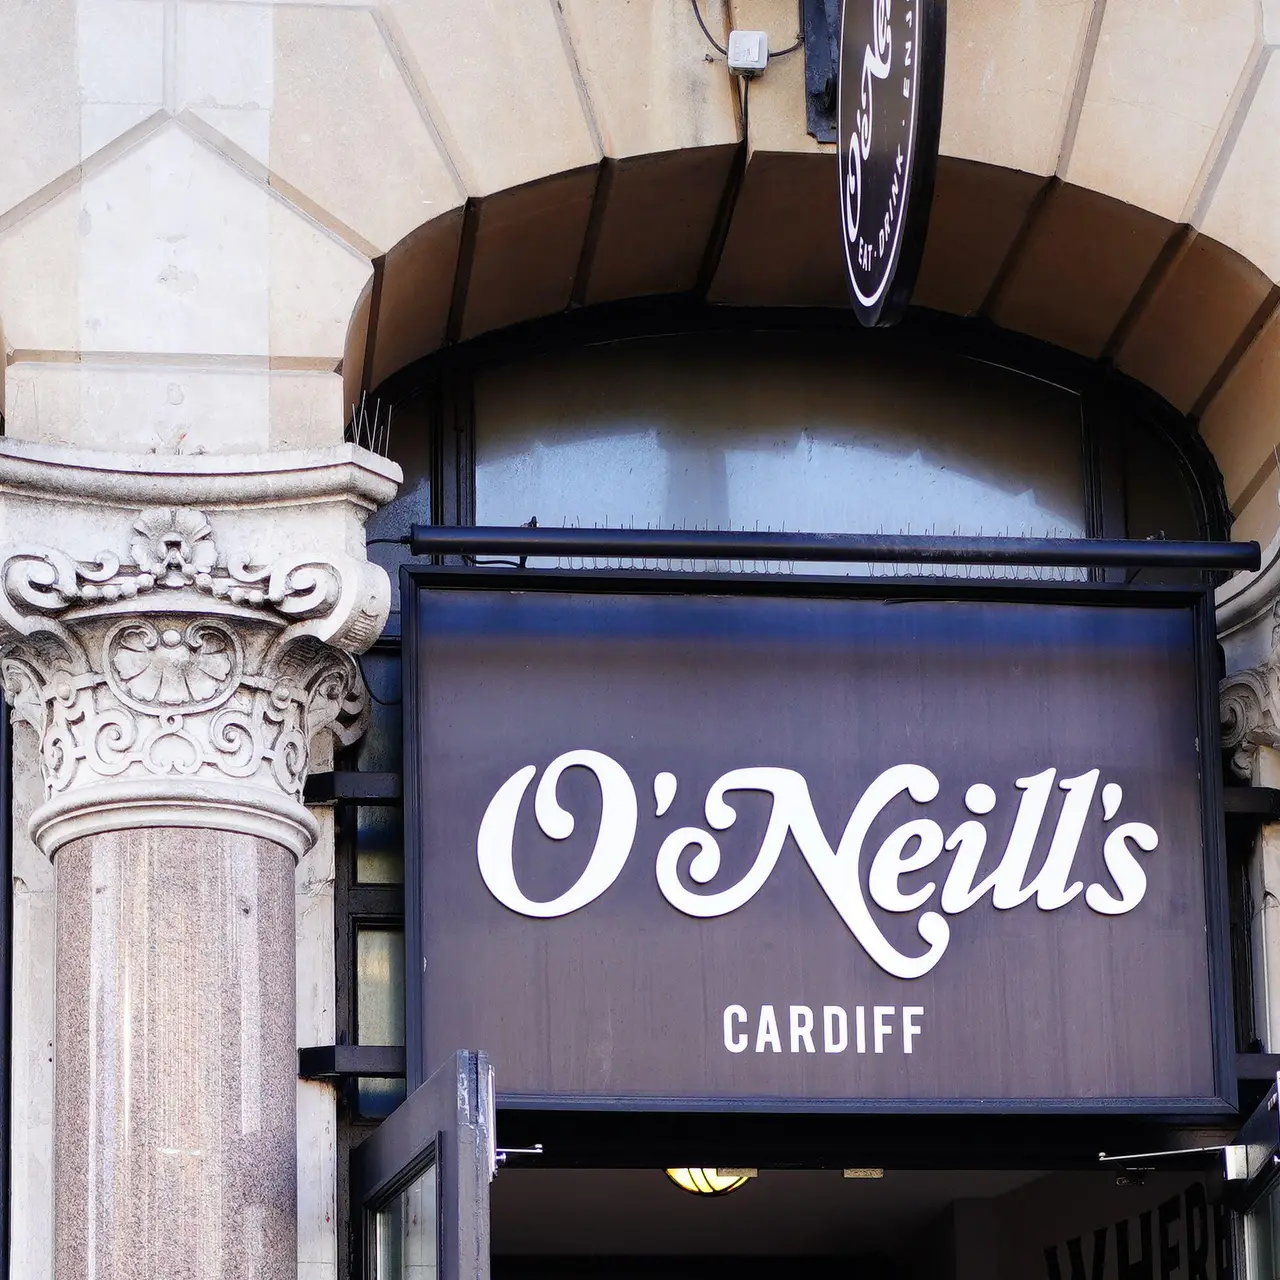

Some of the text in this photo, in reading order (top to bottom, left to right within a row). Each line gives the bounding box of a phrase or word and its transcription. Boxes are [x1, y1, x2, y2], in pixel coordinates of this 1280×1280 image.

[858, 236, 873, 272] EAT
[878, 143, 904, 258] DRINK
[477, 749, 1160, 979] O'Neill's
[723, 1003, 926, 1054] CARDIFF
